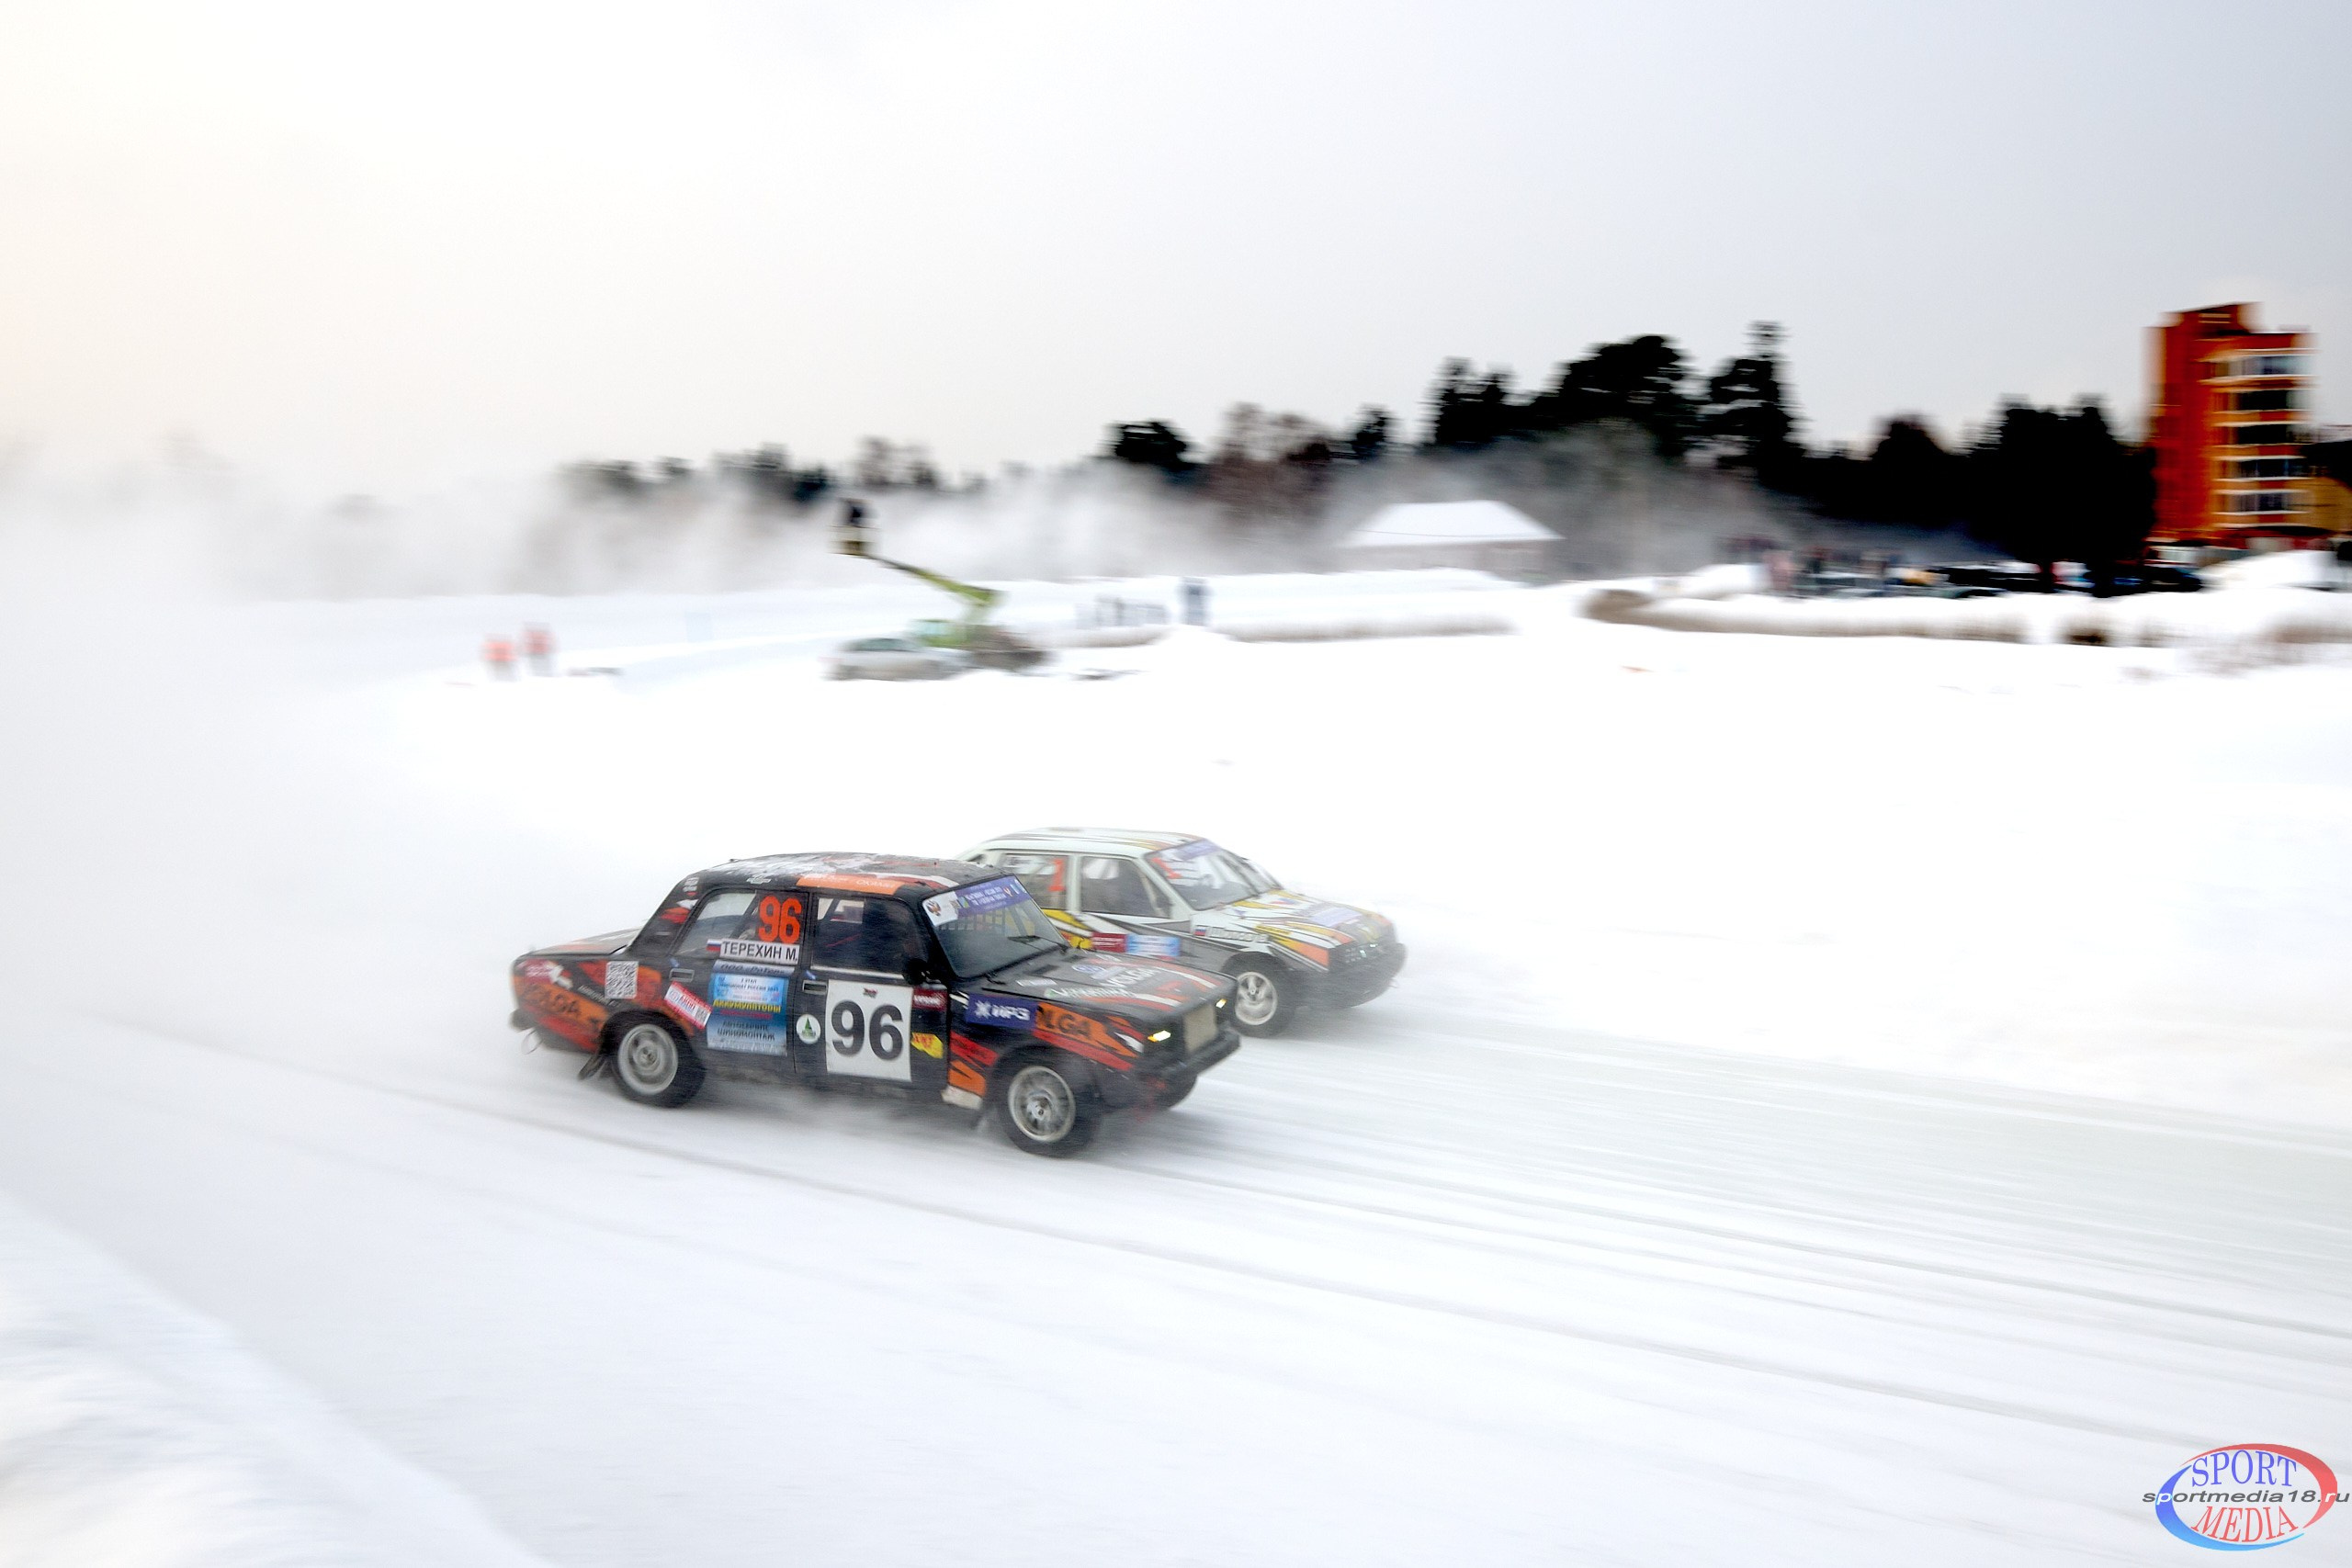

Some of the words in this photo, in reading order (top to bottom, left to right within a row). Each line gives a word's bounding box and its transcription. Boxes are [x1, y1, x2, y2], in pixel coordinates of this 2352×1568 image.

[1048, 858, 1066, 892] 1
[758, 895, 802, 944] 96
[721, 941, 782, 959] ТЕРЕХИН
[786, 946, 798, 962] М.
[831, 998, 903, 1061] 96
